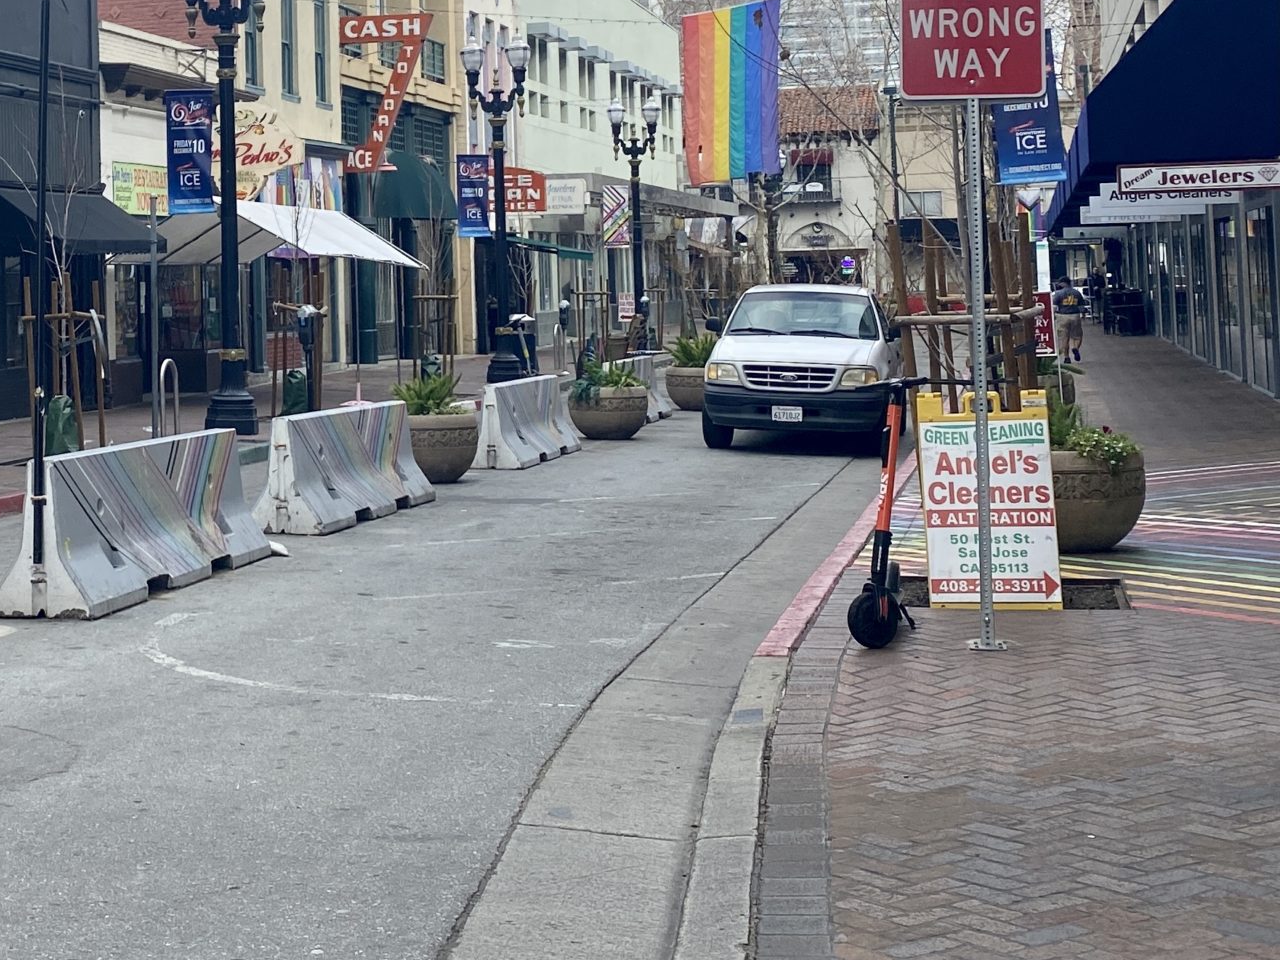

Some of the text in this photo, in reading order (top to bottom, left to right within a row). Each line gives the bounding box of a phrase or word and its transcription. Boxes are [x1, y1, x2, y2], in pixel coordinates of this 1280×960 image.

[344, 18, 420, 38] CASH
[909, 6, 1036, 39] WRONG
[397, 46, 414, 74] TO
[933, 47, 1011, 78] WAY
[373, 83, 400, 143] LOAN
[1004, 102, 1032, 112] DECEMBER
[174, 139, 192, 148] FRIDAY
[192, 139, 205, 153] 10
[1016, 134, 1047, 150] ICE
[347, 149, 373, 169] ACE
[180, 174, 200, 186] ICE
[1123, 168, 1255, 189] Dream Jewelers
[475, 187, 483, 197] 10
[467, 210, 482, 219] ICE
[924, 422, 1044, 445] GREEN EANING
[935, 450, 1039, 480] Anel's
[928, 482, 1051, 505] Cleners
[931, 511, 1051, 525] & ALTRATION
[950, 533, 1035, 545] 50 Pst St.
[958, 547, 1028, 558] Sa Jose
[991, 563, 1029, 573] 95113
[939, 580, 1047, 592] 408-28-3911
